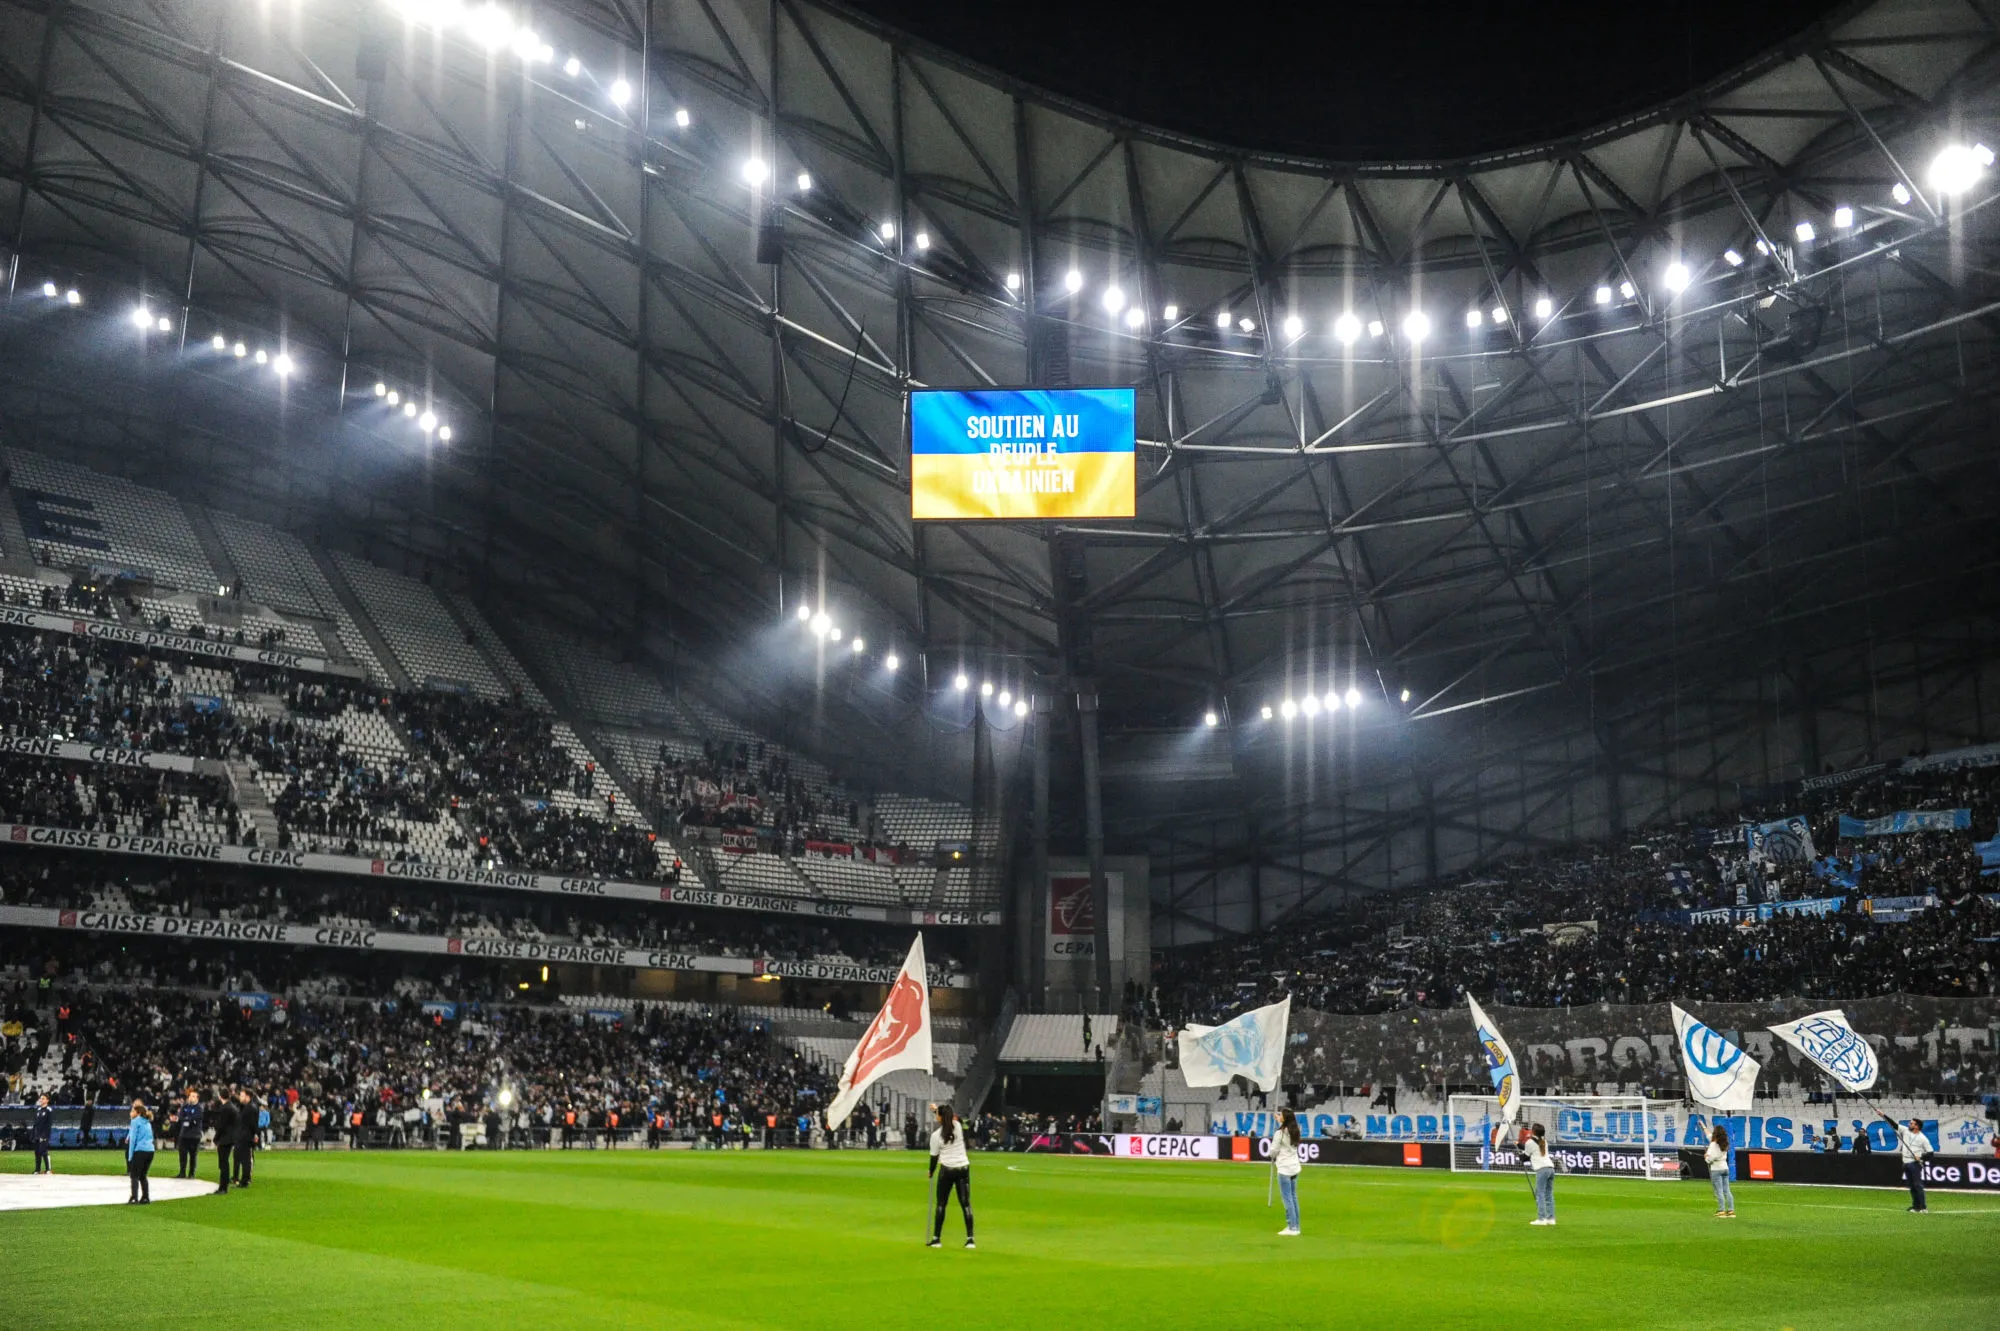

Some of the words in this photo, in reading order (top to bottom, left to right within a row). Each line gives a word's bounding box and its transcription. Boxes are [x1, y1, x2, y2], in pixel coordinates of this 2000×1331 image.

[967, 415, 1045, 438] SOUTIEN
[1052, 415, 1079, 437] AU
[990, 442, 1058, 466] PEUPLE
[87, 624, 141, 643] CAISSE
[147, 634, 236, 658] D'EPARGNE
[257, 651, 303, 667] CEPAC
[89, 748, 150, 765] CEPAC
[30, 828, 98, 849] CAISSE
[106, 836, 222, 860] D'EPARGNE
[247, 849, 305, 868] CEPAC
[387, 860, 441, 880] CAISSE
[448, 867, 540, 889] D'EPARGNE
[560, 878, 606, 895] CEPAC
[673, 889, 718, 906] CAISSE
[722, 894, 798, 913] D'EPARGNE
[815, 903, 853, 917] CEPAC
[80, 912, 155, 932] CAISSE
[162, 917, 287, 942] D'EPARGNE
[938, 911, 990, 924] CEPAC
[315, 927, 375, 947] CEPAC
[1053, 942, 1094, 955] CEPA
[464, 939, 522, 958] CAISSE
[528, 944, 626, 965] D'EPARGNE
[648, 952, 697, 969] CEPAC
[766, 960, 813, 978] CAISSE
[818, 965, 896, 984] D'EPARGNE
[926, 972, 955, 987] EPAC
[1527, 1034, 1676, 1078] DROI
[1235, 1111, 1353, 1139] VIAGE
[1366, 1114, 1466, 1142] NORD
[1557, 1109, 1658, 1143] CLUB
[1683, 1113, 1793, 1150] AMIS
[1147, 1136, 1201, 1158] CEPAC
[1258, 1138, 1320, 1163] Oge
[1902, 1161, 1961, 1182] lice
